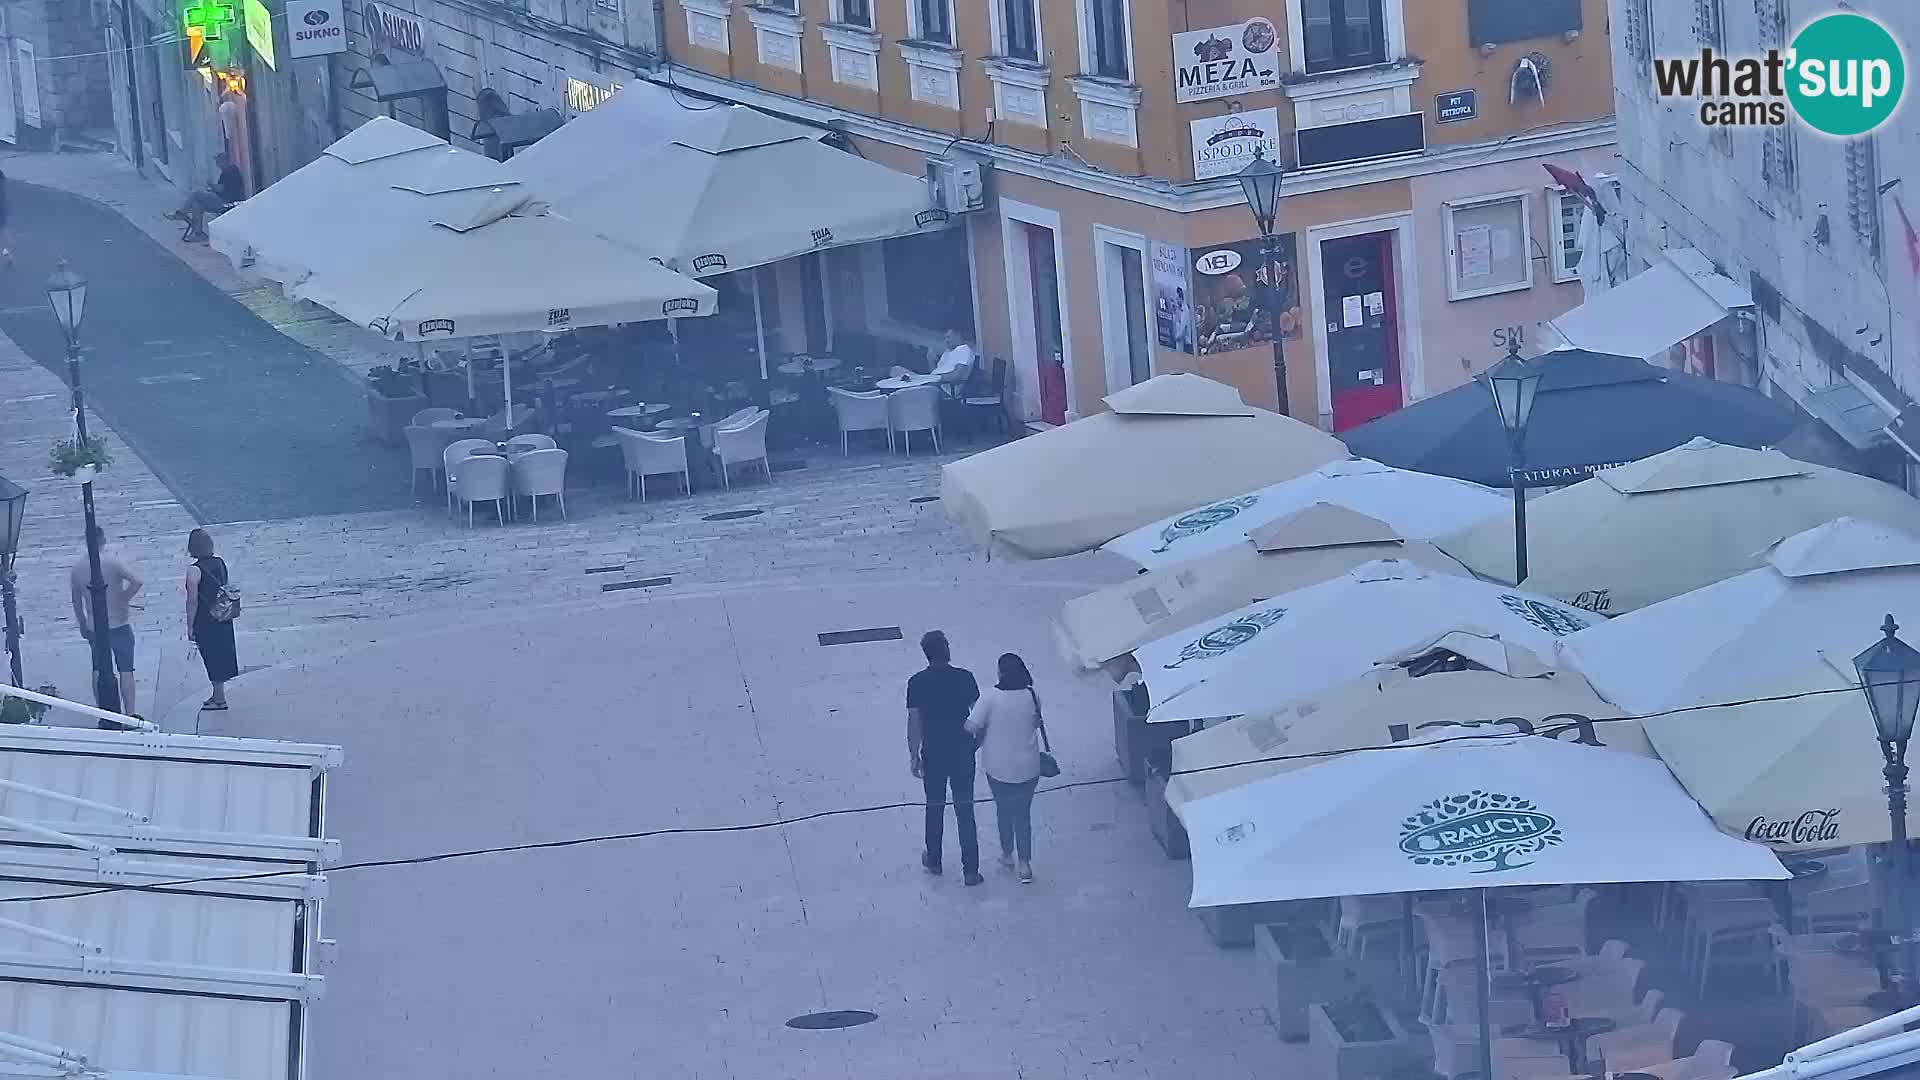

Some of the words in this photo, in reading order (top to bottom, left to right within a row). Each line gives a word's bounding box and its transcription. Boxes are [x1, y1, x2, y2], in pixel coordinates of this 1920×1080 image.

[296, 27, 340, 41] SUKNO
[382, 11, 422, 50] SUKNO
[1179, 57, 1258, 88] MEZA
[1188, 83, 1220, 96] PIZZERIA
[1222, 83, 1228, 92] &
[1228, 79, 1249, 91] GRILL
[1198, 143, 1243, 161] ISPOD
[1439, 817, 1537, 846] RAUCH
